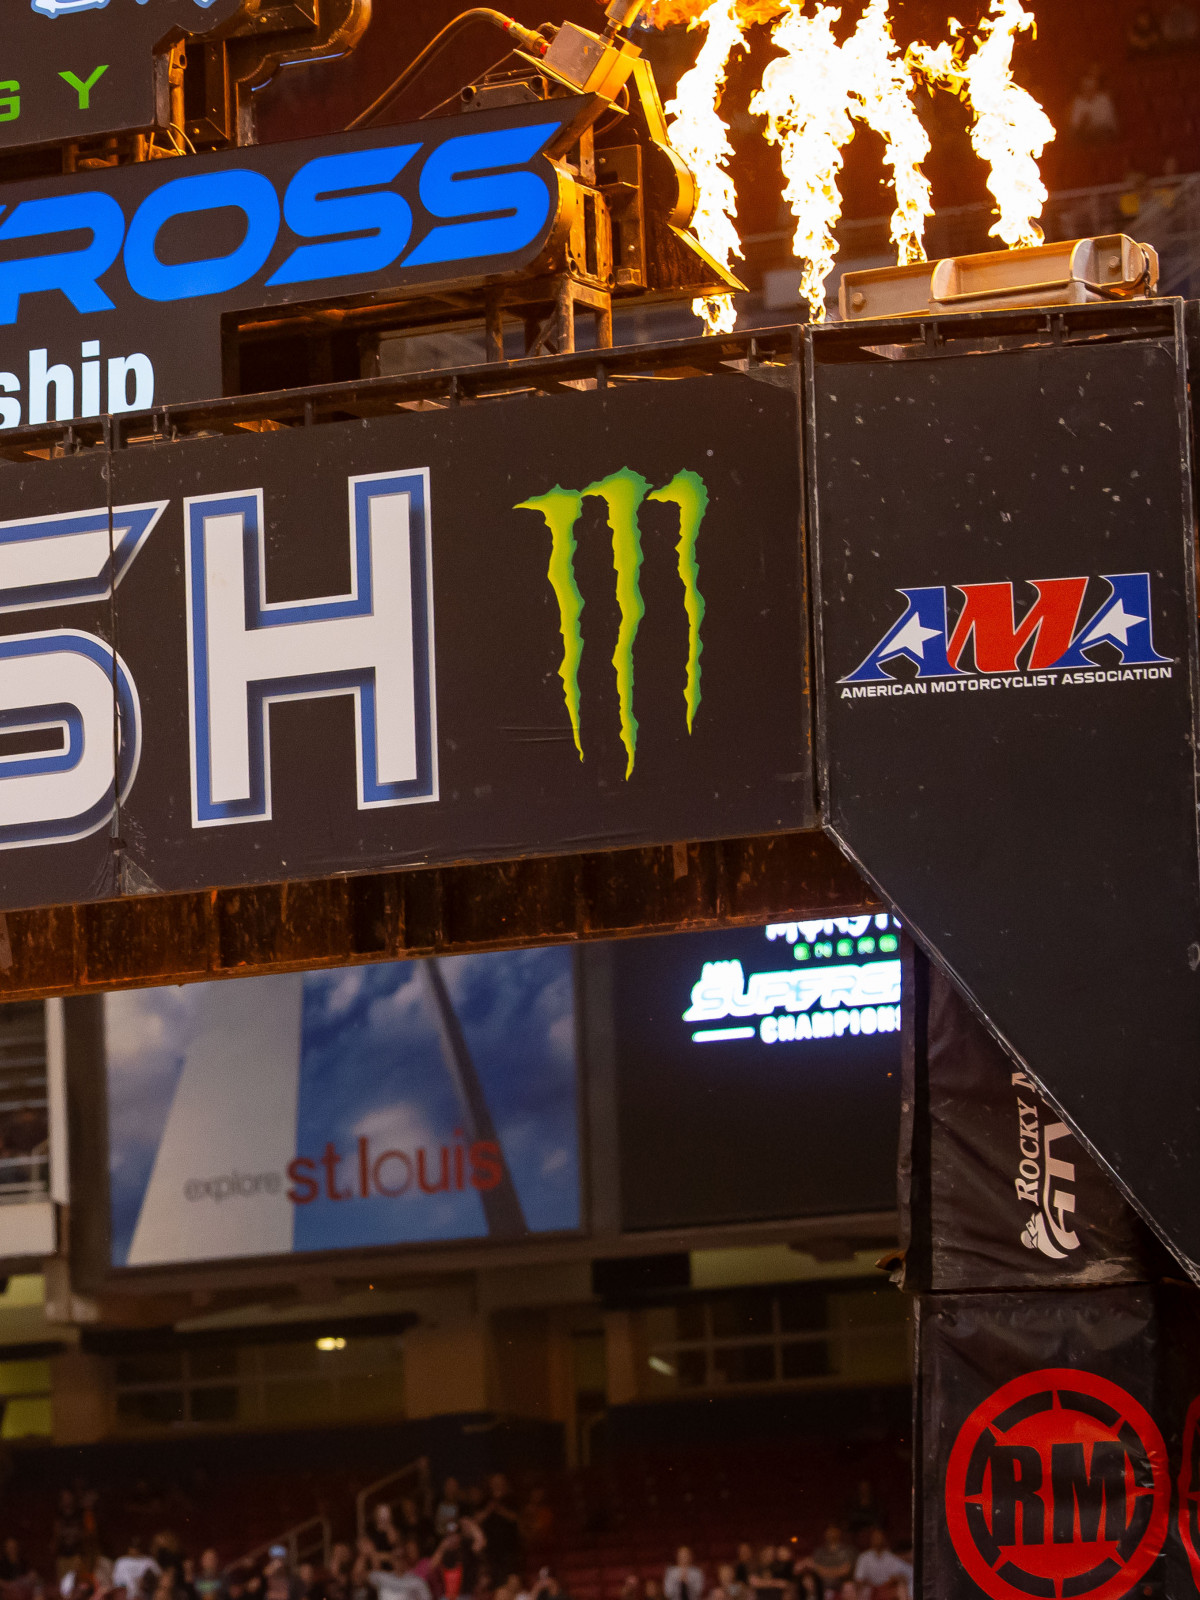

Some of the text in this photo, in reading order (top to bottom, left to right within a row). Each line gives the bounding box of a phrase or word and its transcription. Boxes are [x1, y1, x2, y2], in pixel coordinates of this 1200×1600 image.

[836, 572, 1174, 683] AMA
[840, 667, 1173, 699] AMERICAN MOTORCYCLIST ASSOCIATION
[184, 1170, 282, 1203] explore
[1014, 1096, 1040, 1206] ROCKY
[990, 1441, 1128, 1546] RM
